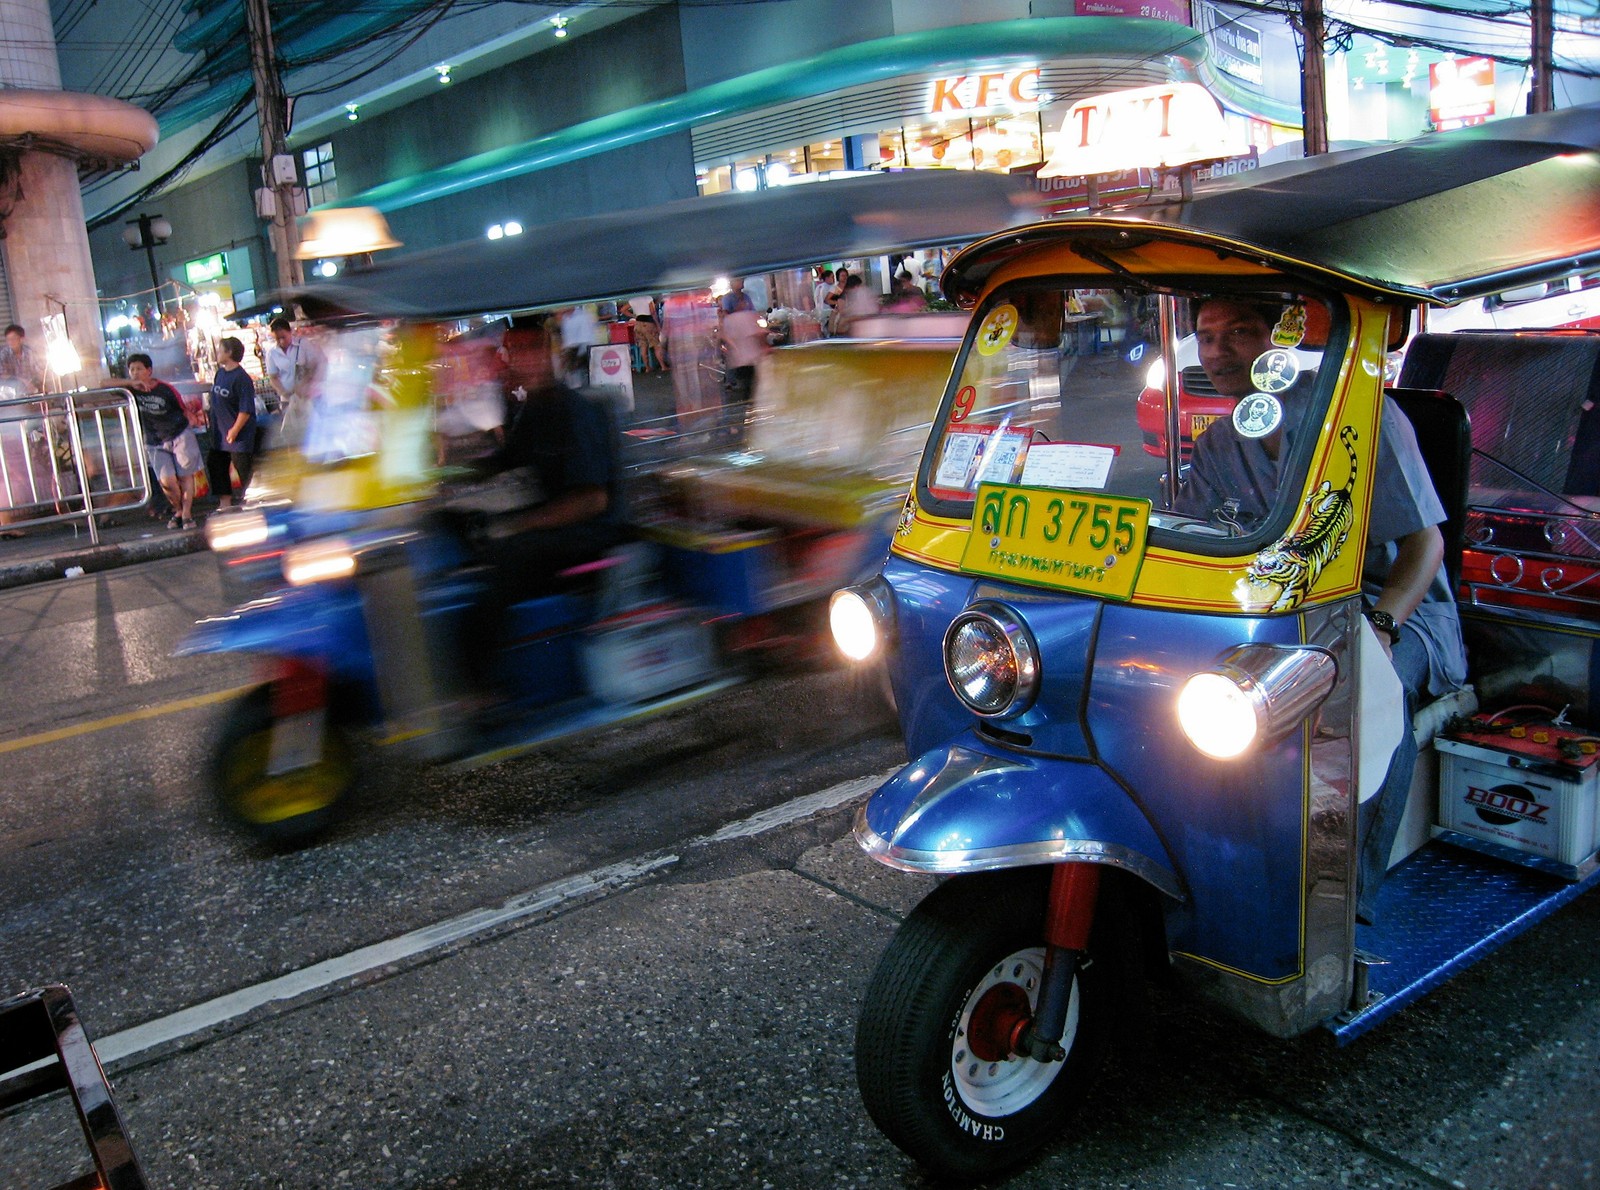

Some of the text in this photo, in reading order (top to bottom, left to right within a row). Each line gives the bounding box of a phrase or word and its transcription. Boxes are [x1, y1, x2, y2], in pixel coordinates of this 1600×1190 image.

[930, 67, 1041, 114] KFC
[1072, 93, 1174, 148] TI
[951, 385, 976, 422] 9
[981, 489, 1139, 555] สก 3755
[988, 550, 1107, 583] กรุงเทพมหานคร
[1463, 786, 1549, 820] BOOZ
[941, 1068, 1005, 1141] CHAMPION
